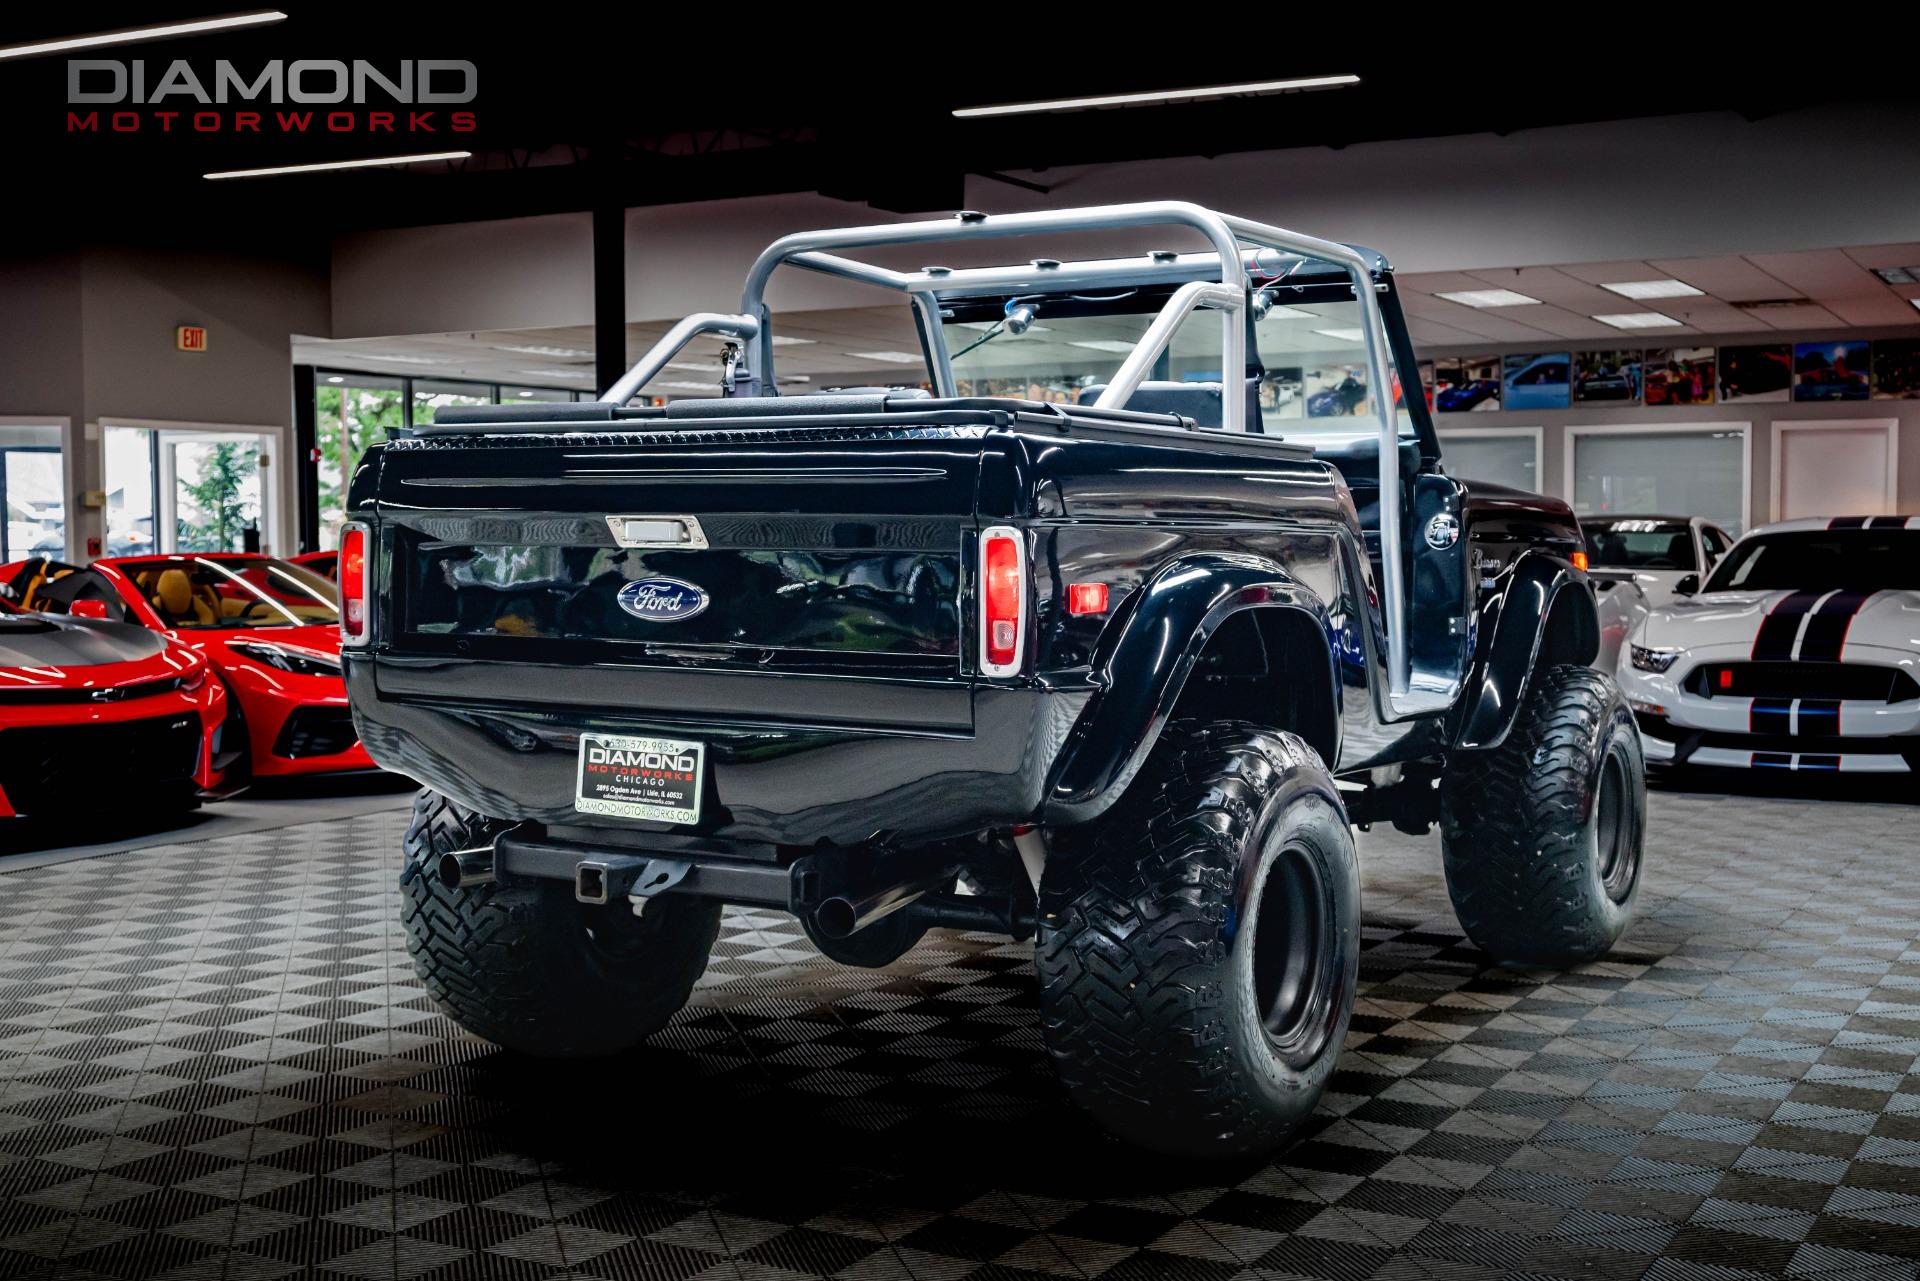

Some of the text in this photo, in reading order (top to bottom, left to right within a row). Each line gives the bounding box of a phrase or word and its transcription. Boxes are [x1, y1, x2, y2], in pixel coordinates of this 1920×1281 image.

[183, 328, 204, 349] EXIT
[633, 584, 683, 611] Ford
[609, 739, 674, 752] 630-579-9955
[590, 748, 694, 771] DIAMOND
[587, 765, 693, 780] MOTORWORKS
[615, 775, 664, 786] CHICAGO
[595, 784, 609, 792] 2895
[609, 786, 629, 795] Ogden
[666, 791, 683, 800] 60532
[576, 800, 697, 821] DIAMONDMOTORWORKS.COM
